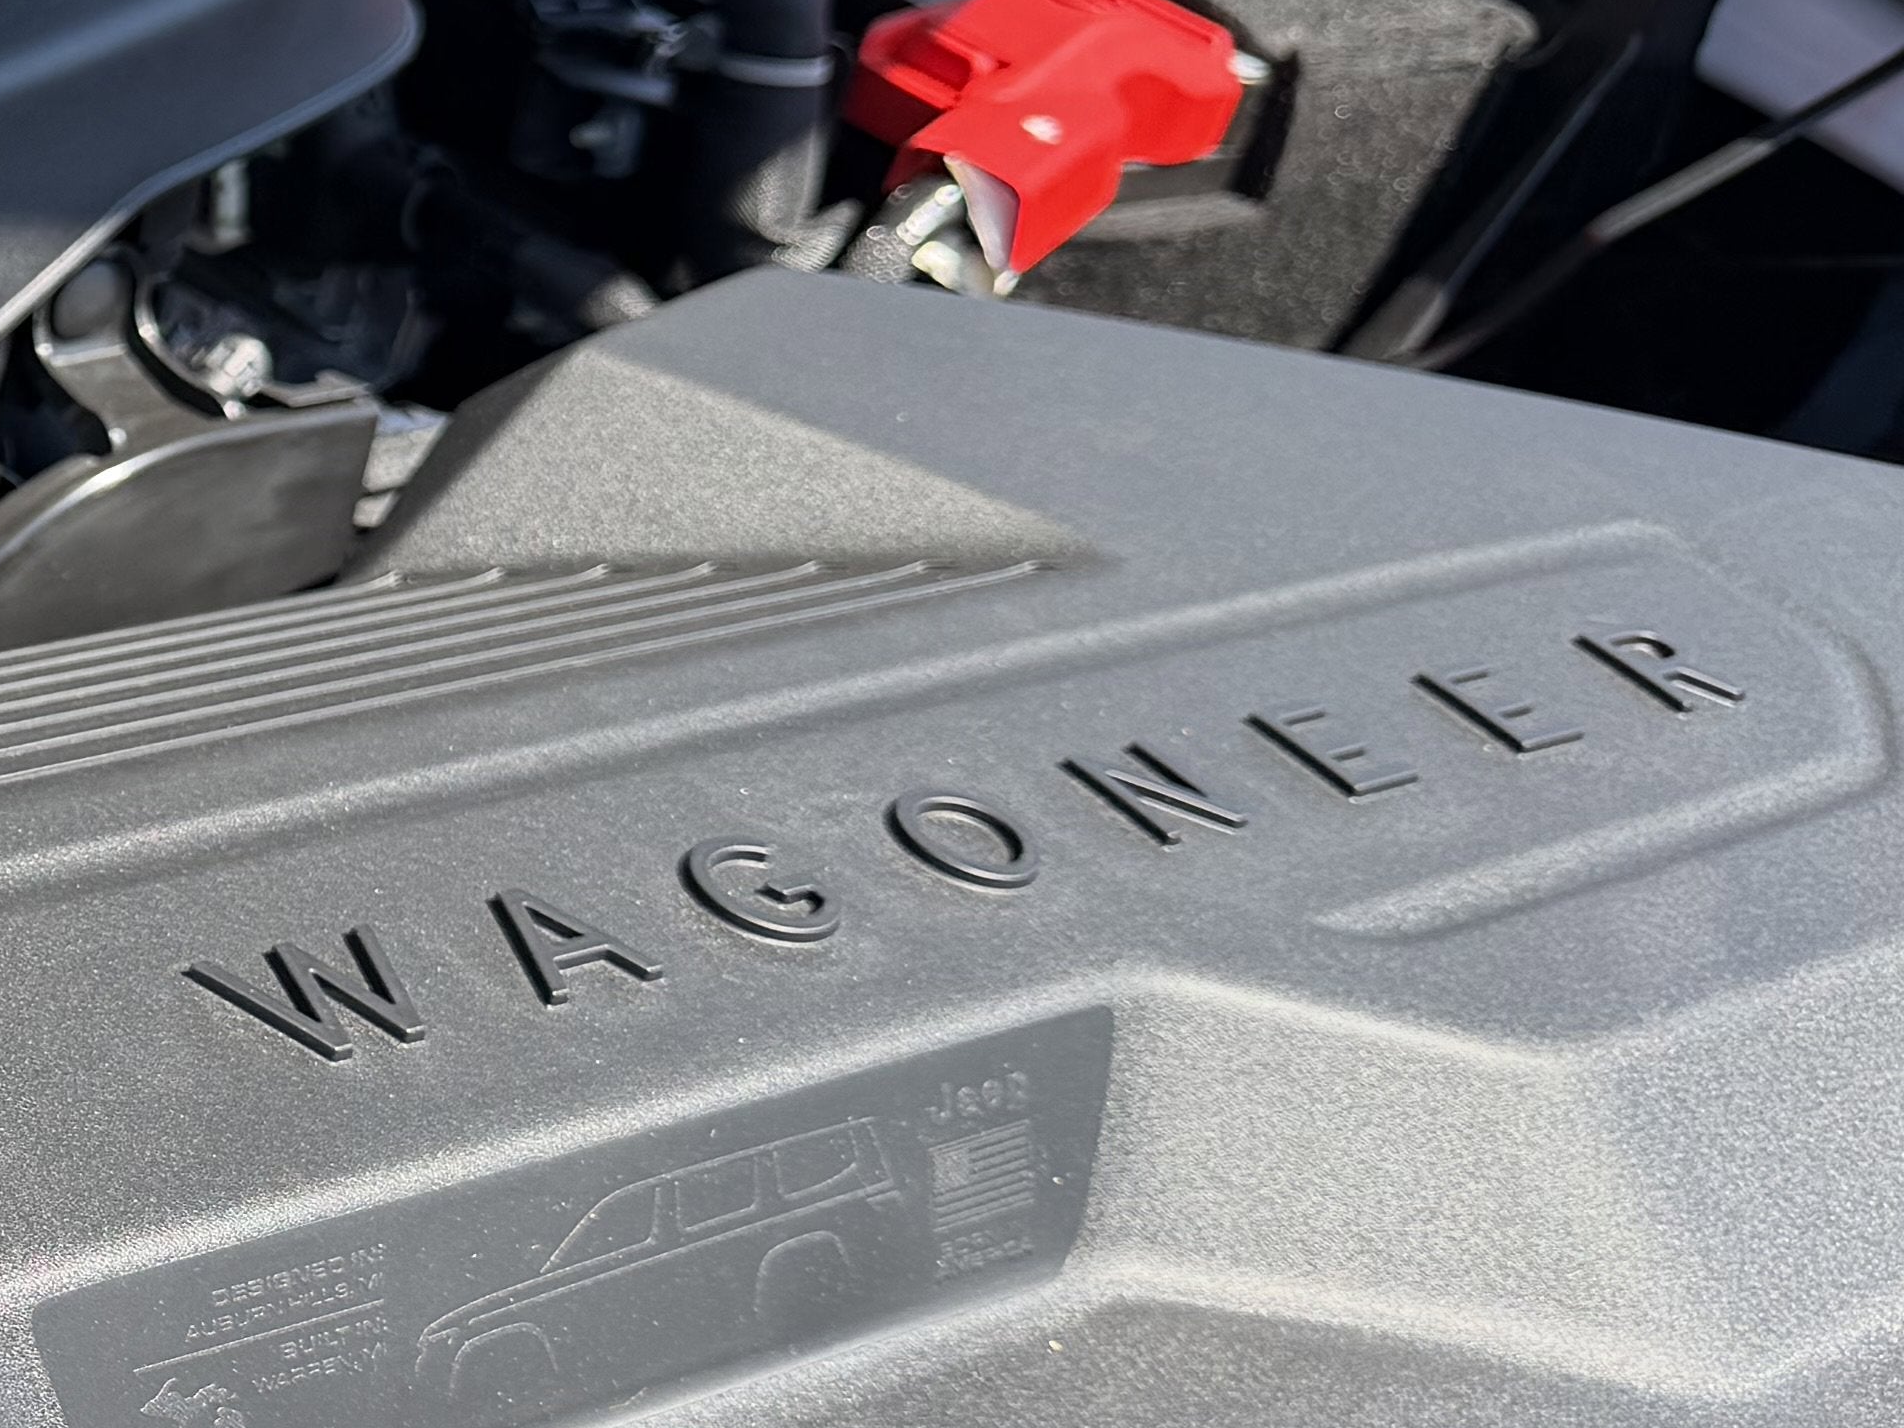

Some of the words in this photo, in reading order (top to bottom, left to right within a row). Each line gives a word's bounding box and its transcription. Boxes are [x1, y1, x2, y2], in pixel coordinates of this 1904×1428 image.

[184, 628, 1746, 1062] WAGONEER
[211, 1255, 345, 1307] DESIGNED
[184, 1301, 284, 1343] AUBURN
[280, 1324, 350, 1359] BUILT
